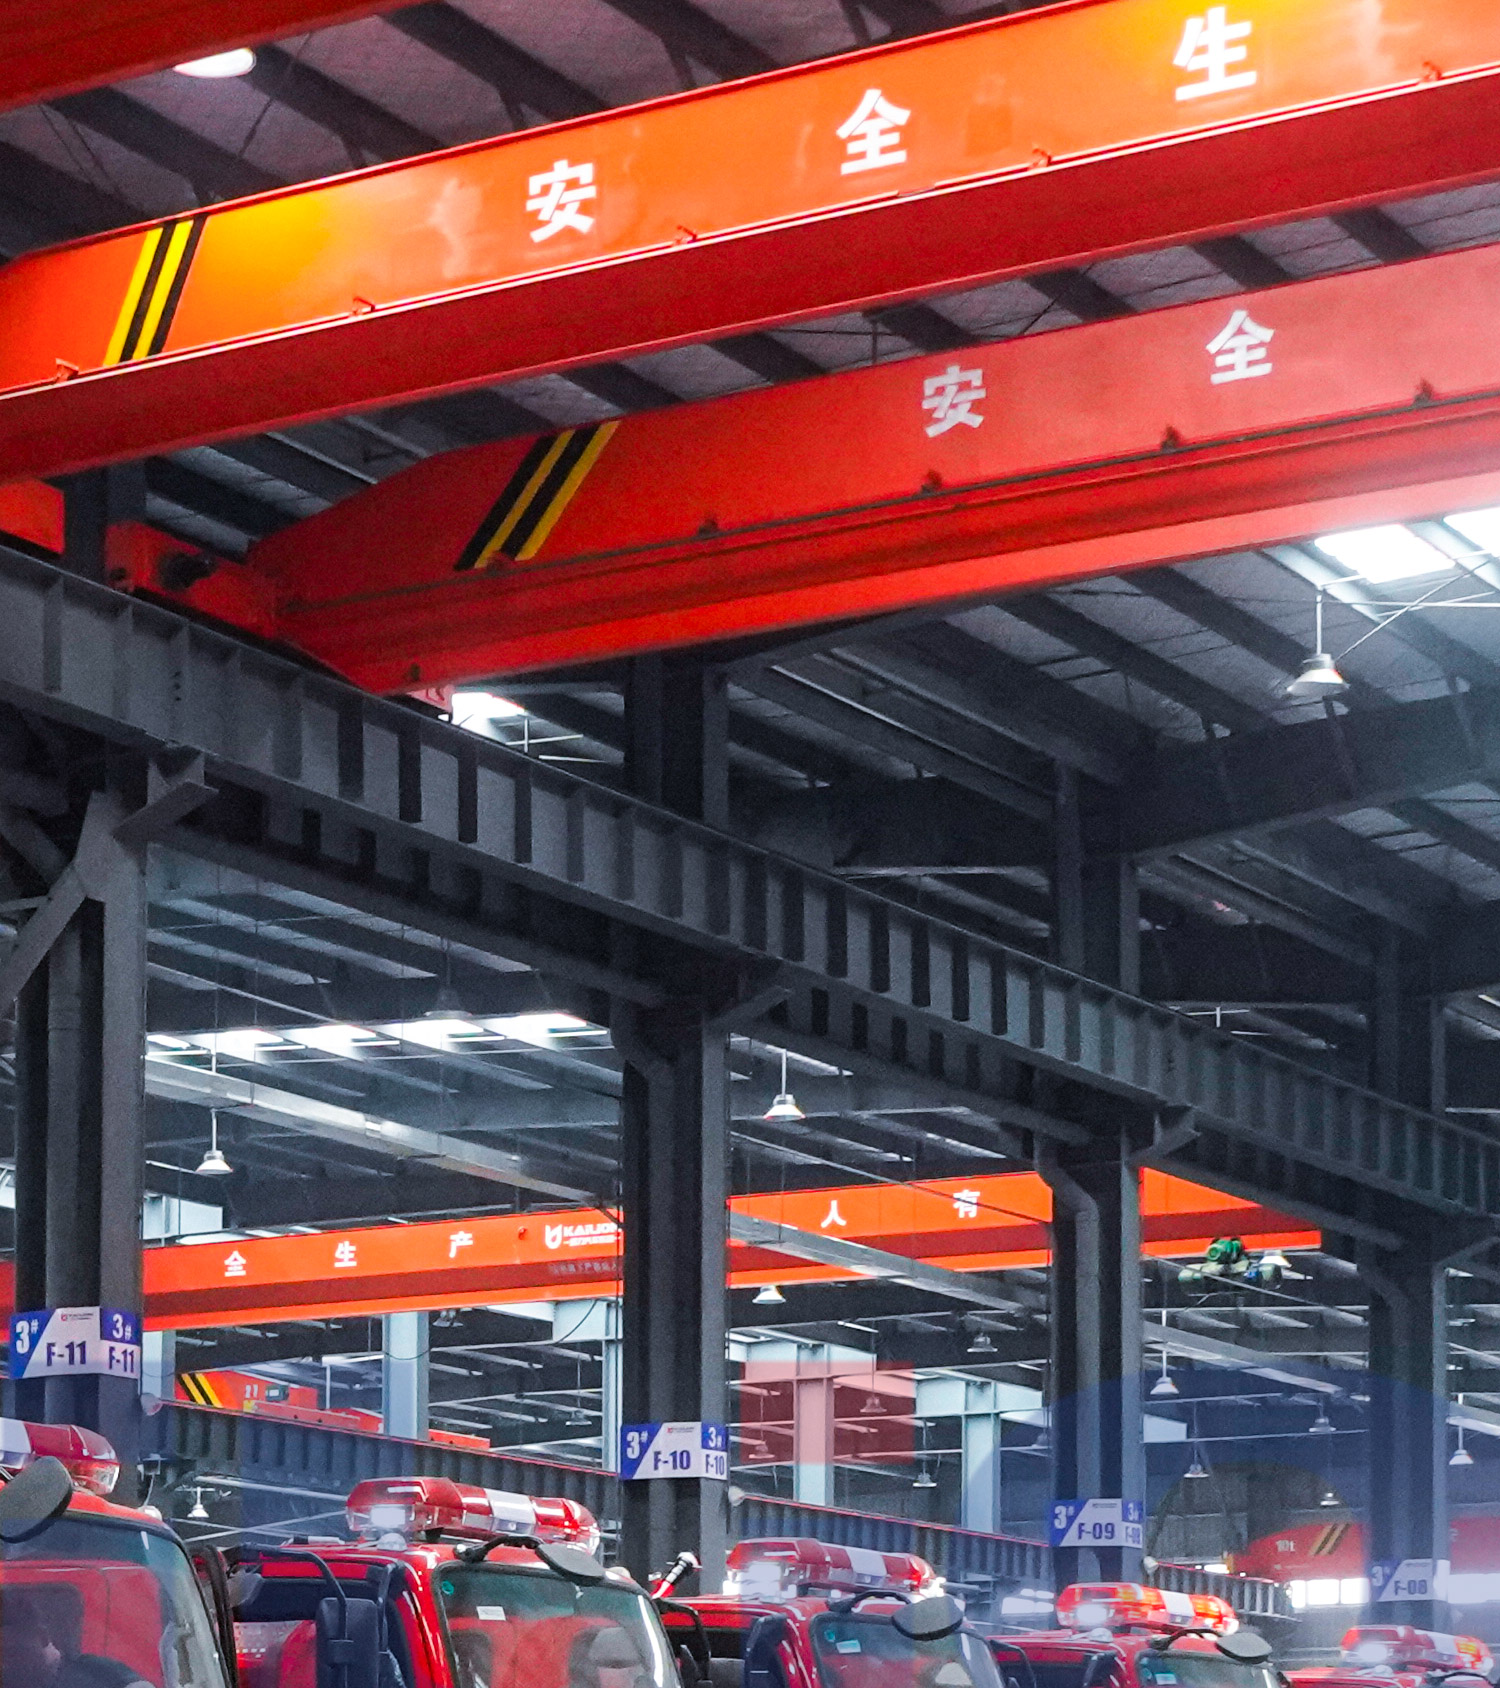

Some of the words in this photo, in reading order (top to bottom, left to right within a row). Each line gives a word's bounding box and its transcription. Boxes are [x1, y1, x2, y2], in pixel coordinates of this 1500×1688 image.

[15, 1318, 38, 1354] 3#
[46, 1340, 87, 1366] F-11
[109, 1346, 134, 1373] F-11
[653, 1450, 691, 1471] F-10
[705, 1454, 725, 1475] F-10
[1077, 1522, 1115, 1540] F-09
